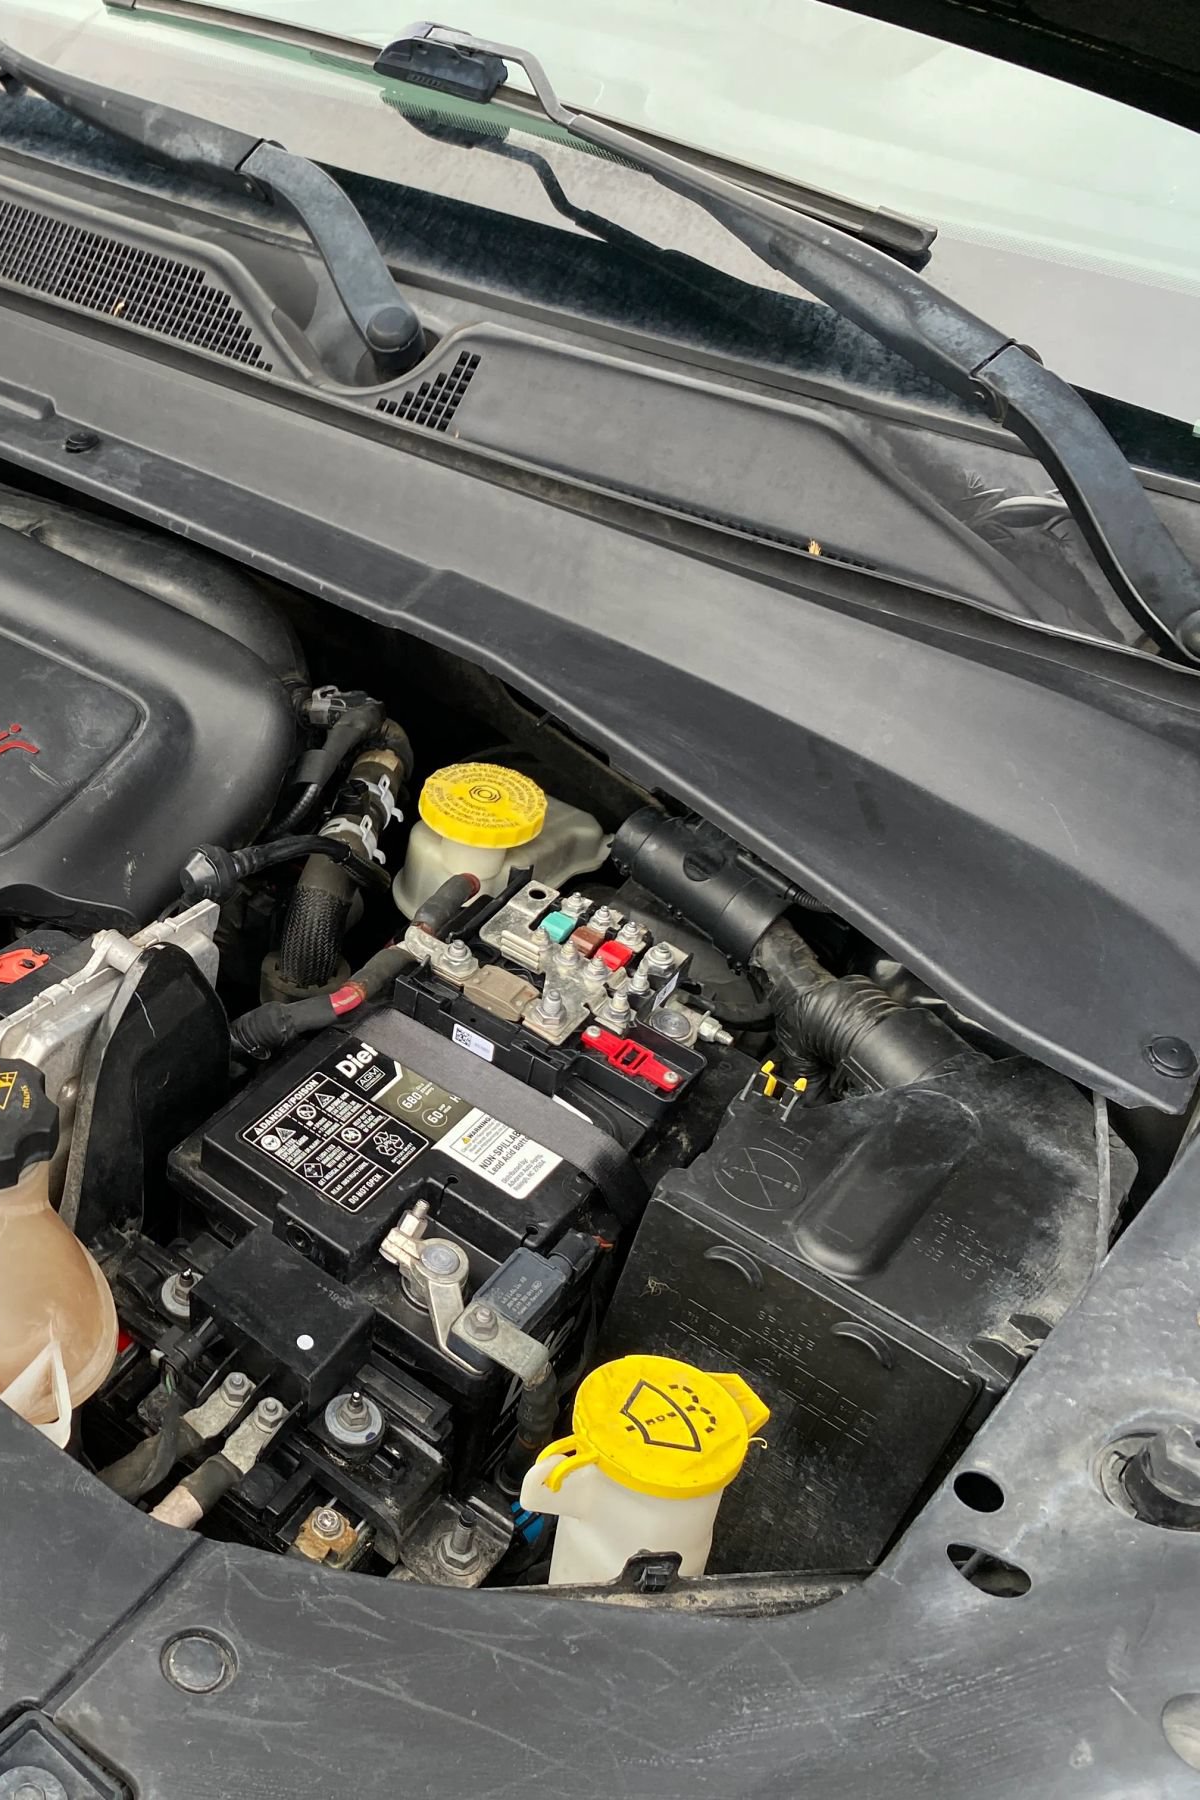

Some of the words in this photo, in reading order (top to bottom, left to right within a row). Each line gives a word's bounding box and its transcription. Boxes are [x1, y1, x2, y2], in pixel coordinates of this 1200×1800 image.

[359, 1067, 379, 1085] AGM
[259, 1079, 319, 1129] DANGER/POISON
[401, 1091, 423, 1109] 680
[427, 1110, 444, 1123] 60
[487, 1160, 505, 1176] Lead
[503, 1148, 517, 1162] Acid
[348, 1195, 360, 1204] DO
[355, 1185, 369, 1197] NOT
